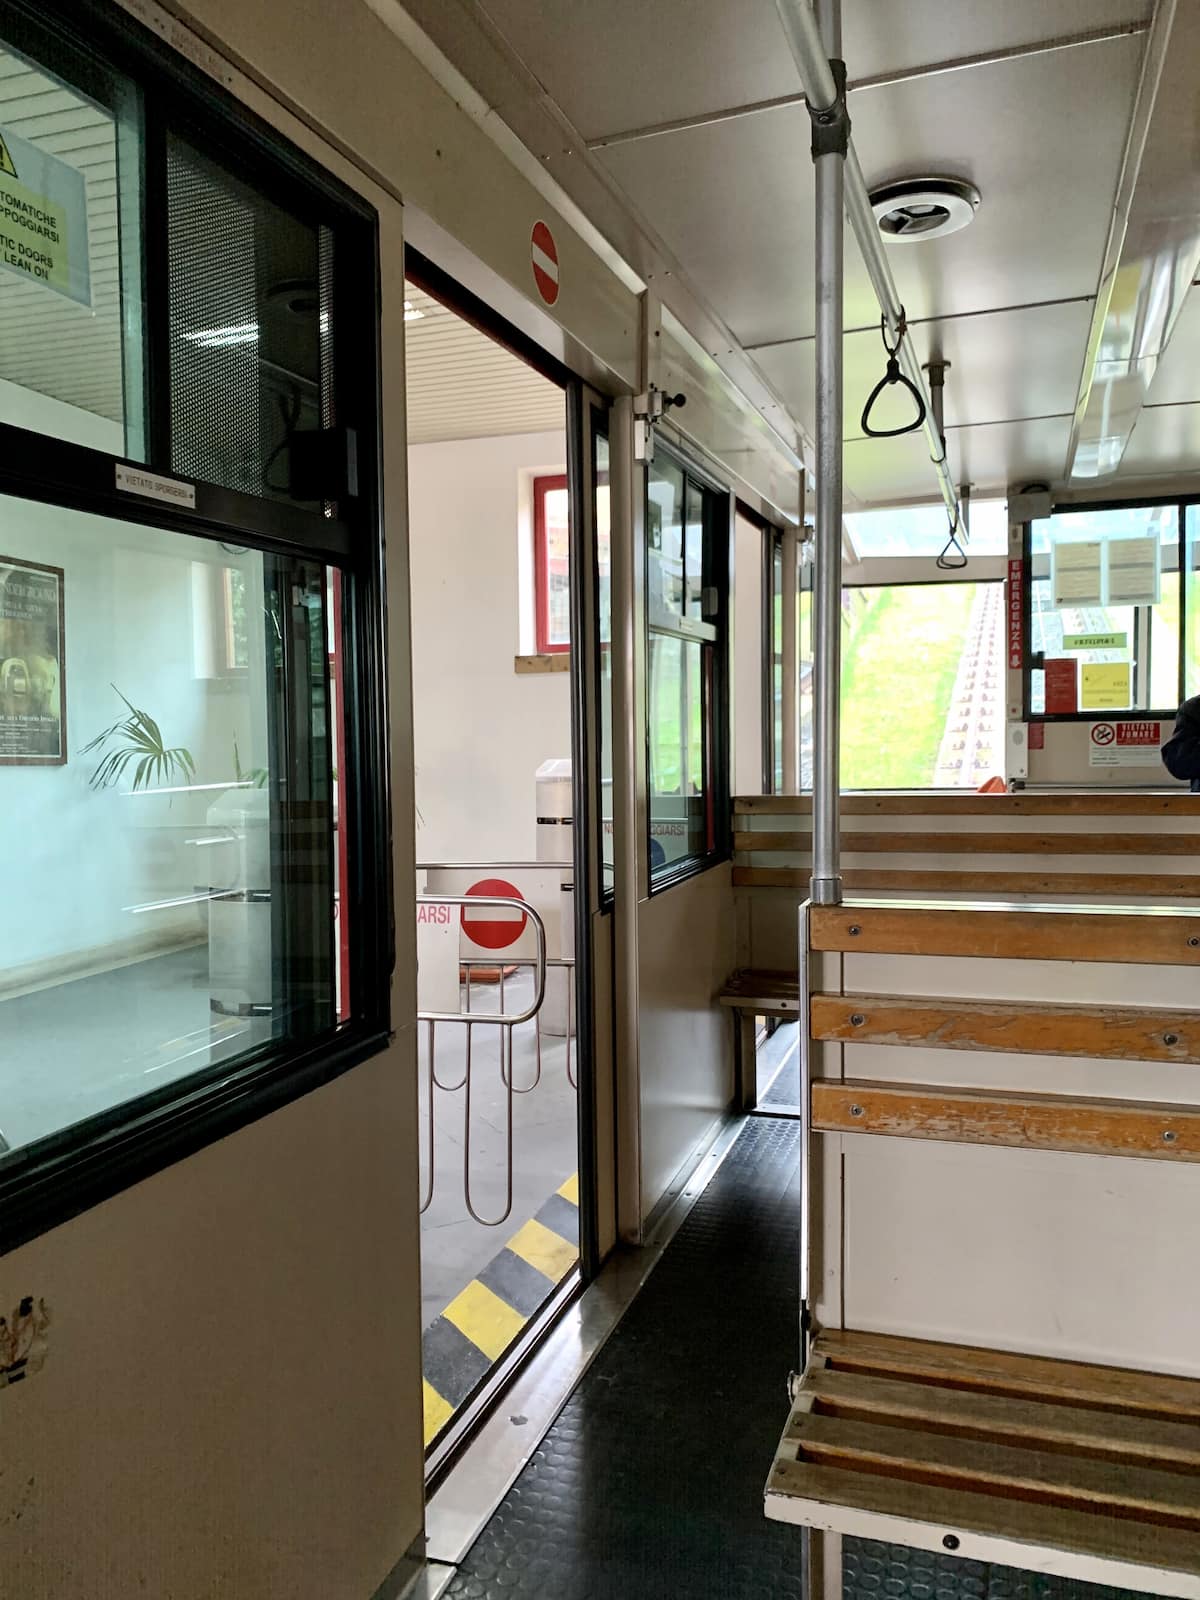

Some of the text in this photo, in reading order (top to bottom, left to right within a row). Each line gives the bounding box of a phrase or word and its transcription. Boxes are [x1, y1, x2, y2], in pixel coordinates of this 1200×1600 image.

[18, 243, 54, 269] DOORS
[4, 251, 48, 280] LEAN ON
[125, 474, 152, 489] VIETATO
[1011, 561, 1020, 650] EMERGENZA
[1121, 723, 1155, 731] VIETATO
[1121, 730, 1155, 738] FUMARE
[418, 906, 450, 924] ARSI
